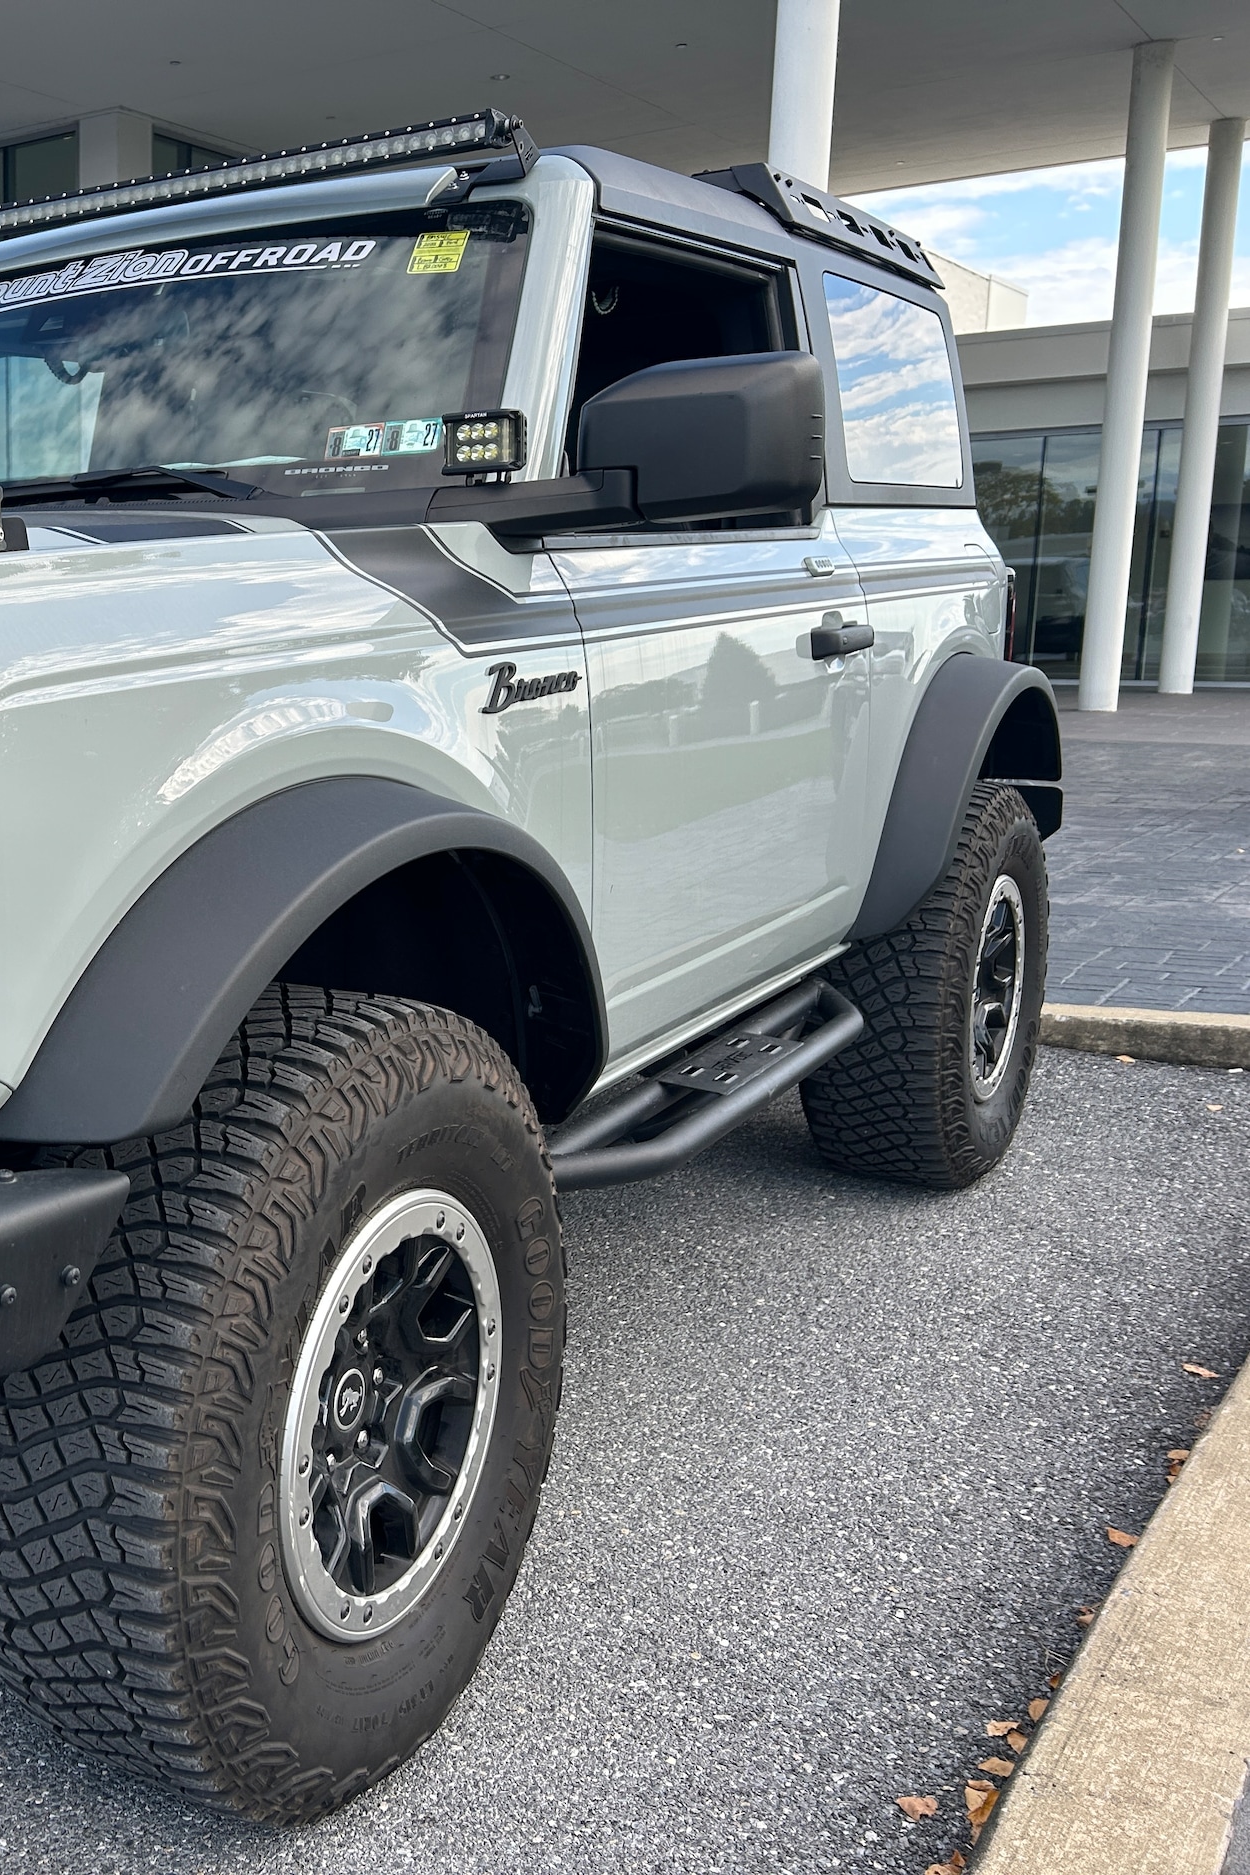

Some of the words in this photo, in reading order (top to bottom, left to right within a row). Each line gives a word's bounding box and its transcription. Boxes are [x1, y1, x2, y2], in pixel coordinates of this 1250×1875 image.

[69, 249, 190, 291] Zion
[178, 240, 377, 275] OFFROAD
[366, 428, 381, 453] 27
[423, 423, 439, 447] 27
[284, 464, 389, 475] BRONCO
[480, 661, 583, 714] Bronco
[462, 1196, 554, 1623] GOODYEAR
